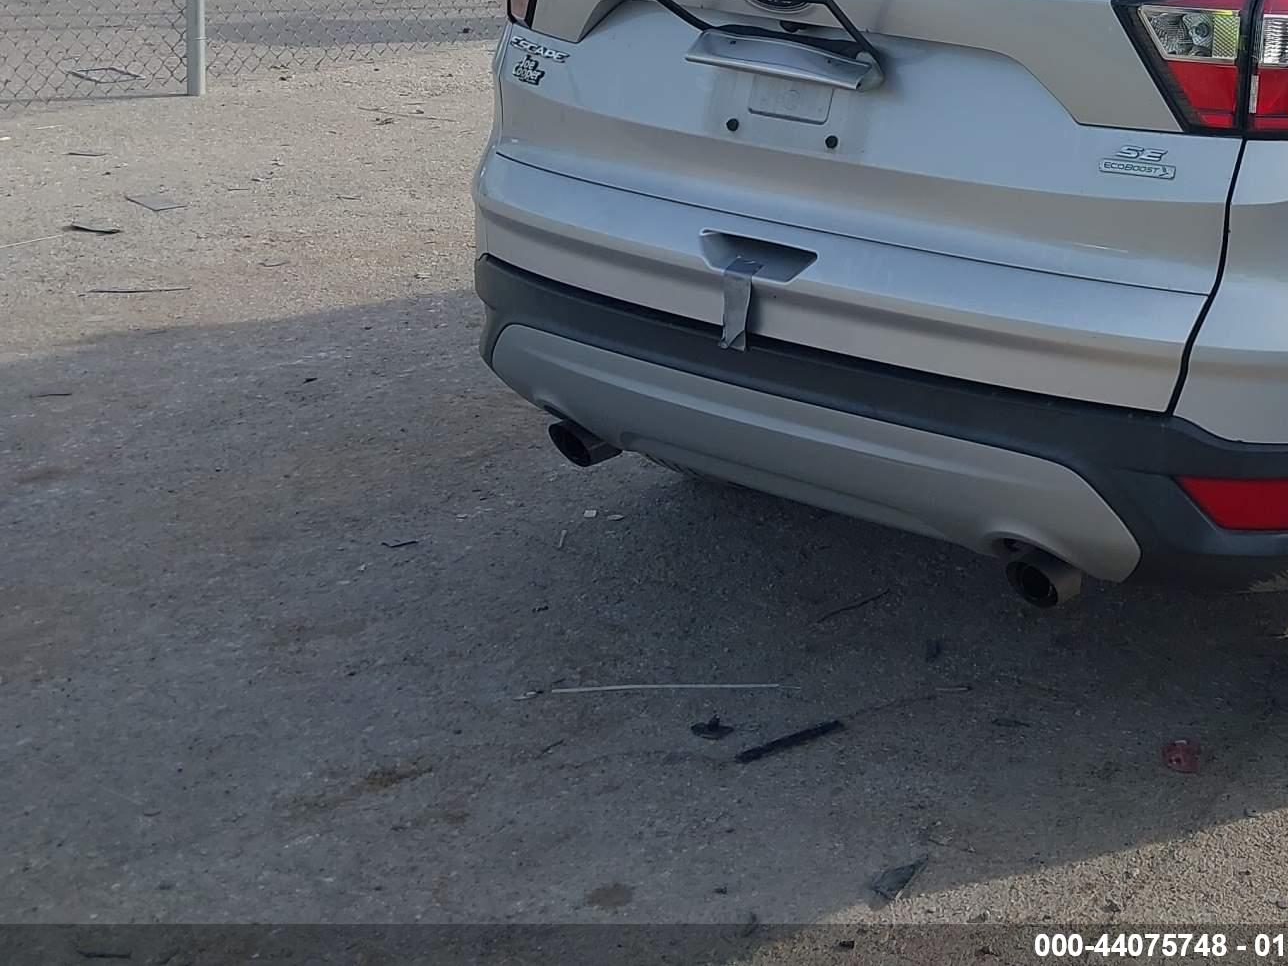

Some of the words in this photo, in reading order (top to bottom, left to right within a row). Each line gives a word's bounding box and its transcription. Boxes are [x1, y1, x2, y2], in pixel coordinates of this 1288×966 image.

[510, 35, 569, 63] ESCAPE
[519, 54, 536, 70] Joe
[512, 63, 542, 81] Cooper
[1115, 145, 1168, 162] SE
